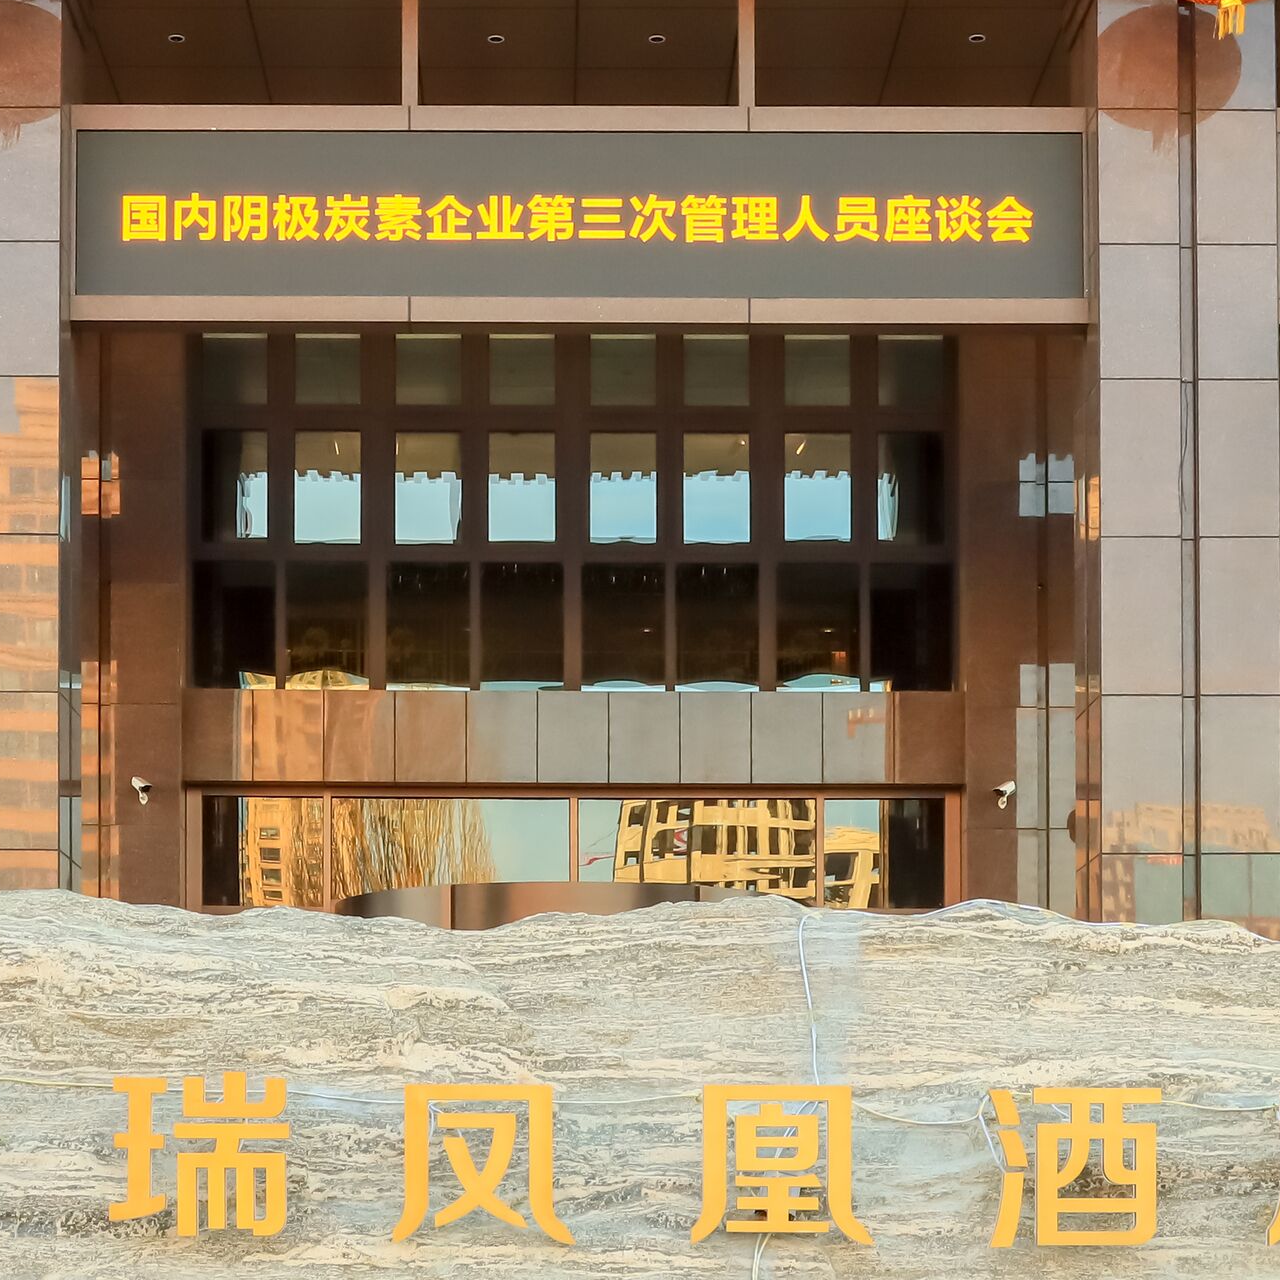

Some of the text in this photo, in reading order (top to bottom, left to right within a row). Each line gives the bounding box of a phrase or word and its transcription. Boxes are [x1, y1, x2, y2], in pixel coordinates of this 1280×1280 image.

[120, 192, 1035, 244] 国内阴极炭素企业第三次管理人员座谈会
